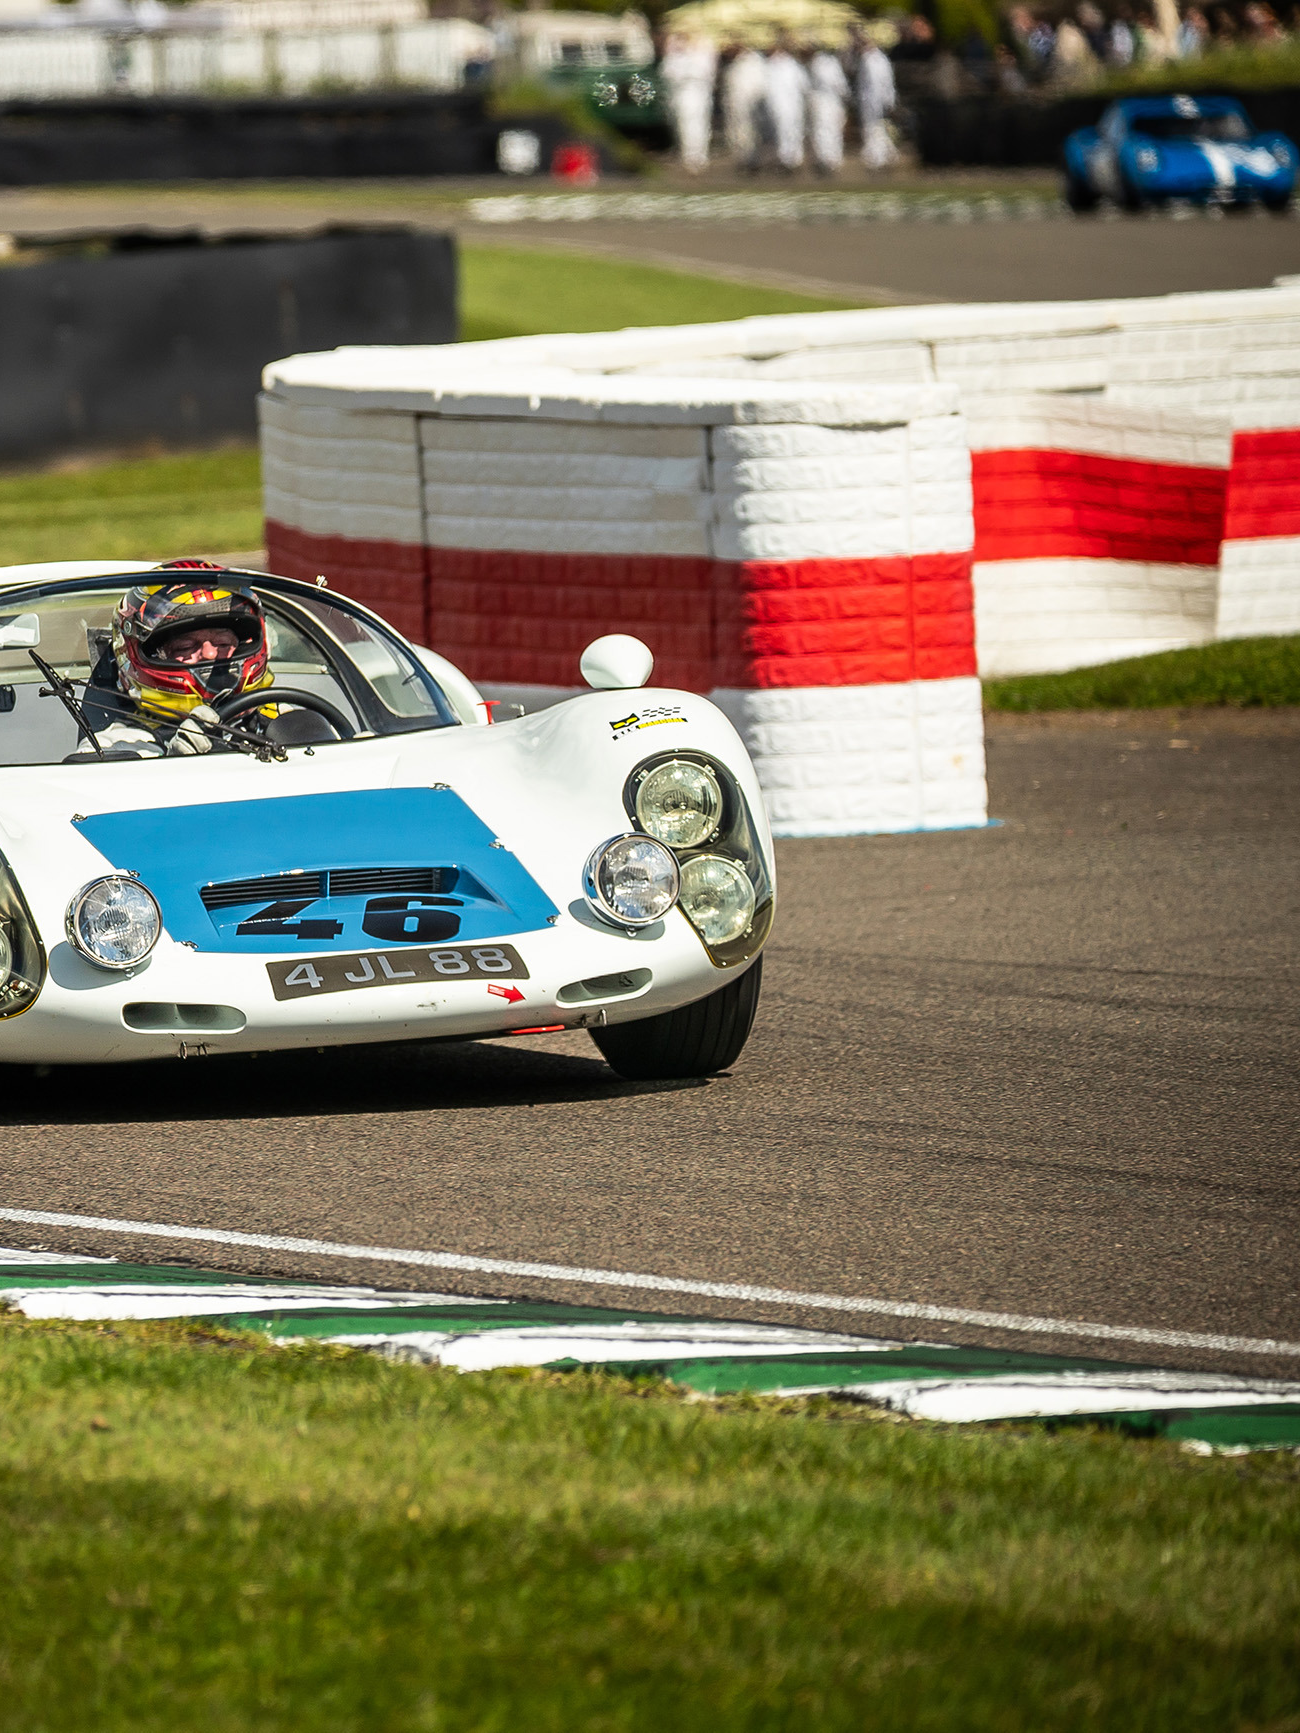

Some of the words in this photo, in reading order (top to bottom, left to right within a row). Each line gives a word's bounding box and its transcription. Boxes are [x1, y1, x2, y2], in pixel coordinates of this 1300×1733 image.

[236, 895, 464, 942] 46
[284, 963, 324, 989] 4
[344, 954, 417, 983] JL
[428, 947, 513, 975] 88
